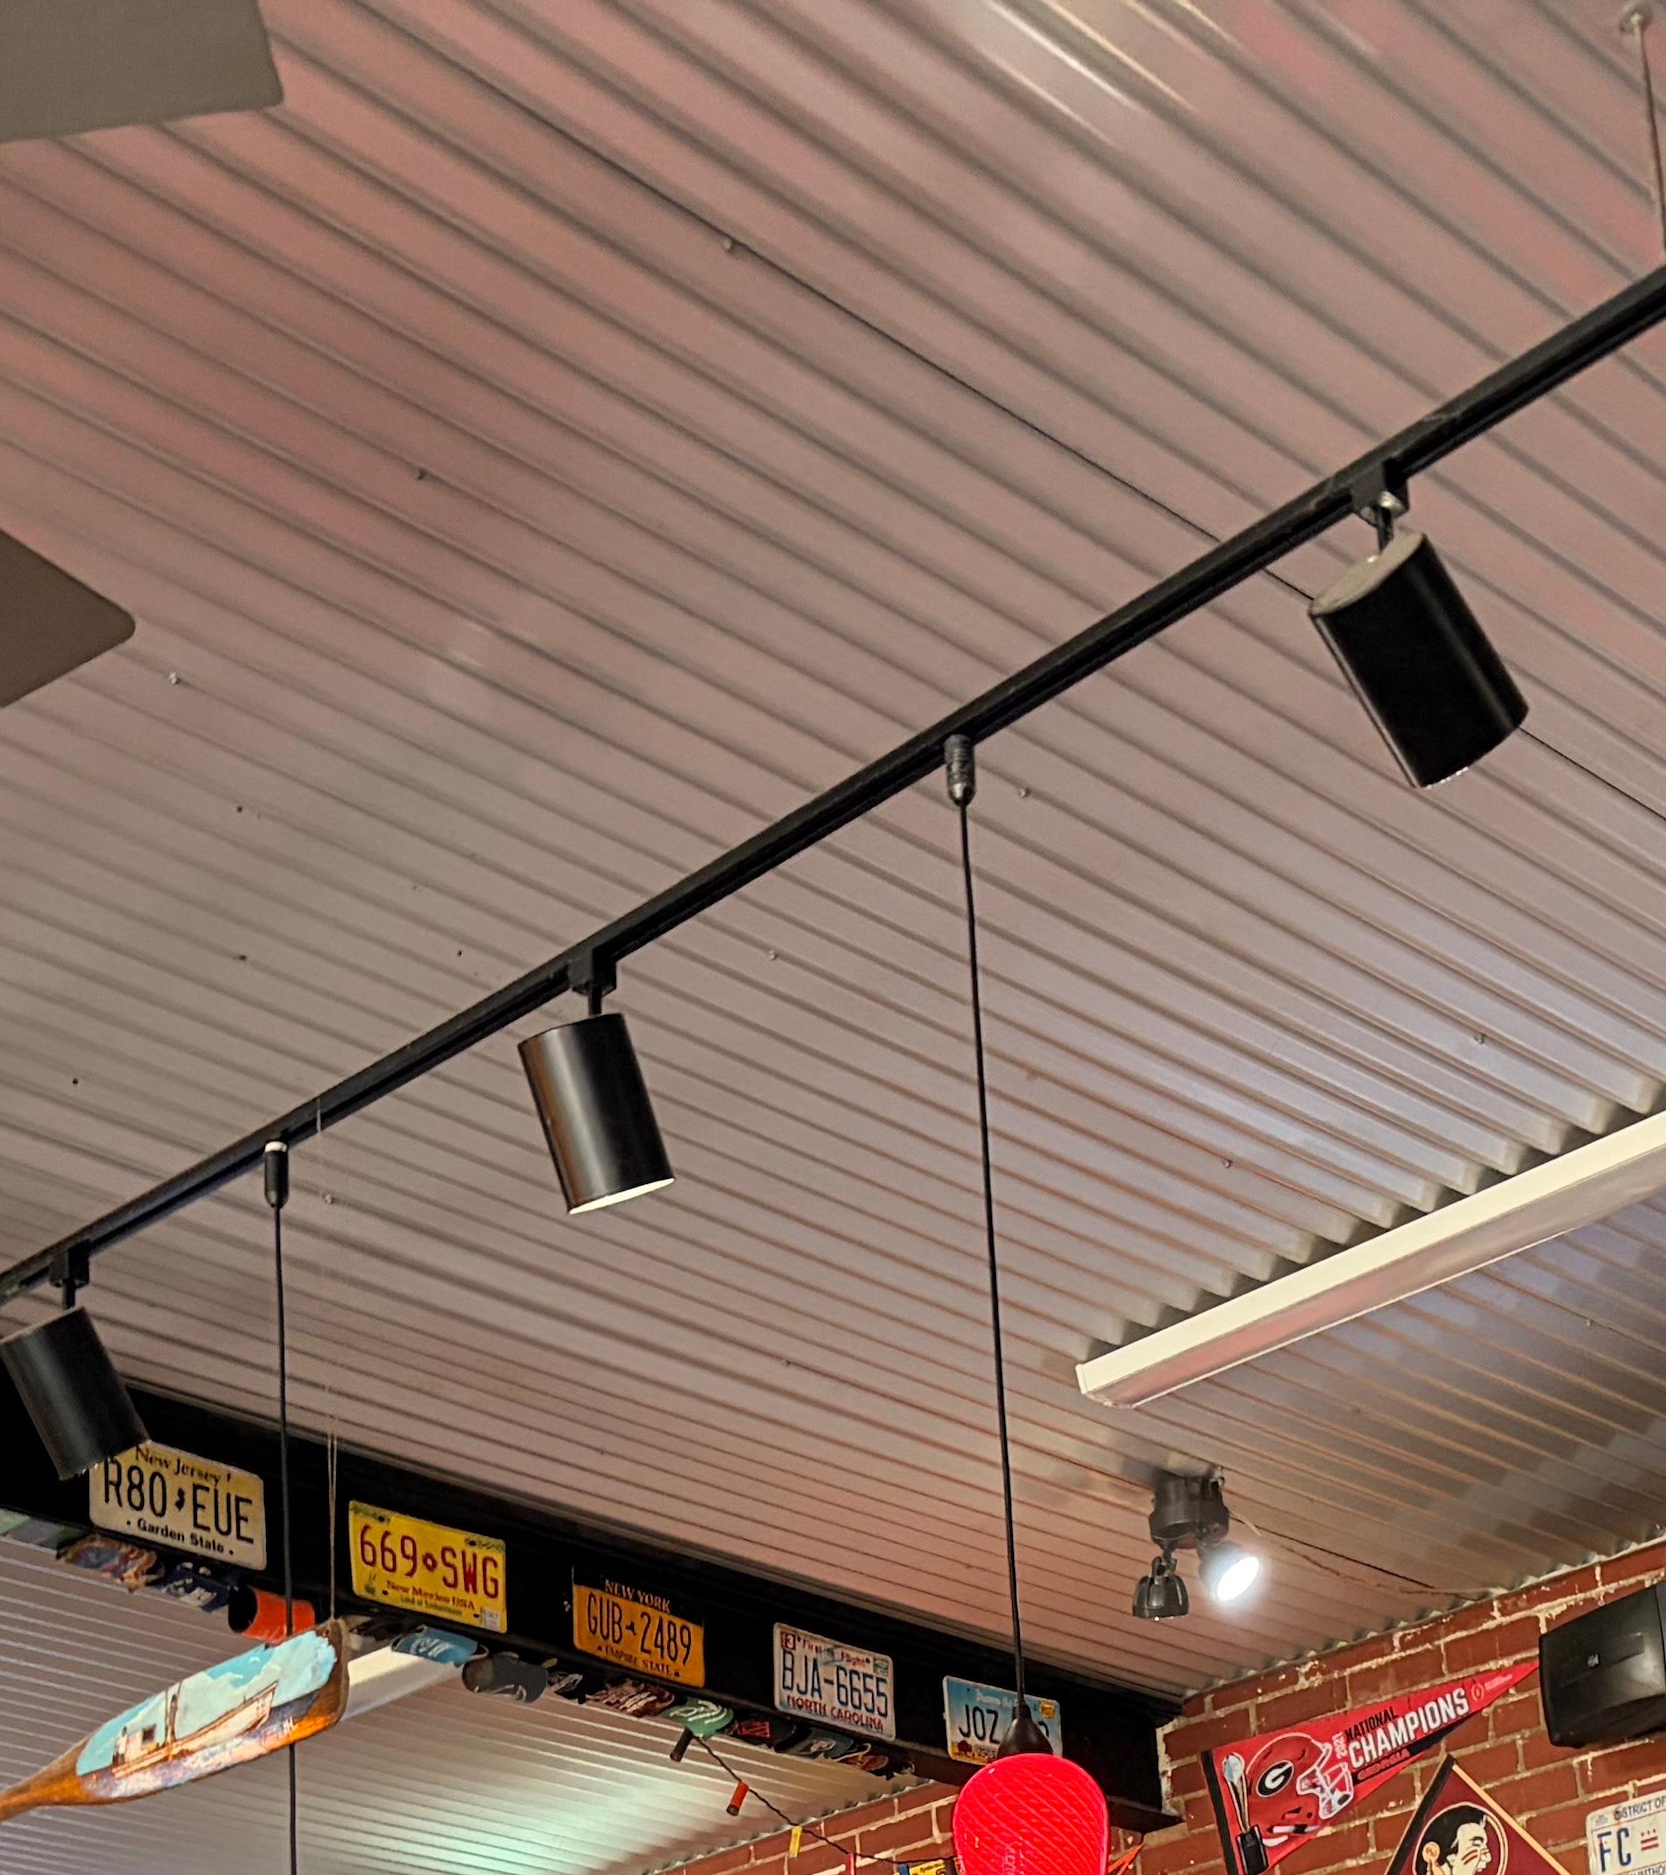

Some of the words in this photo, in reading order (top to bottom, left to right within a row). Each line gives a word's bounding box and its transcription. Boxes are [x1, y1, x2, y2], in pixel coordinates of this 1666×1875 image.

[135, 1447, 161, 1468] New
[165, 1456, 221, 1484] Jersey
[137, 1519, 187, 1544] Garden
[189, 1532, 229, 1554] State
[359, 1528, 417, 1577] 669
[442, 1546, 501, 1599] SWG
[605, 1578, 632, 1598] NEW
[636, 1588, 671, 1613] YORK
[639, 1611, 693, 1667] 2489
[603, 1645, 639, 1667] EMPIRE
[642, 1656, 675, 1676] STATE
[786, 1692, 827, 1717] NORTH
[830, 1703, 884, 1732] CAROLINA
[1345, 1706, 1399, 1741] NATIONAL
[1348, 1690, 1471, 1770] CHAMPIONS
[1357, 1748, 1412, 1782] GEORGIA
[1596, 1827, 1633, 1875] FC
